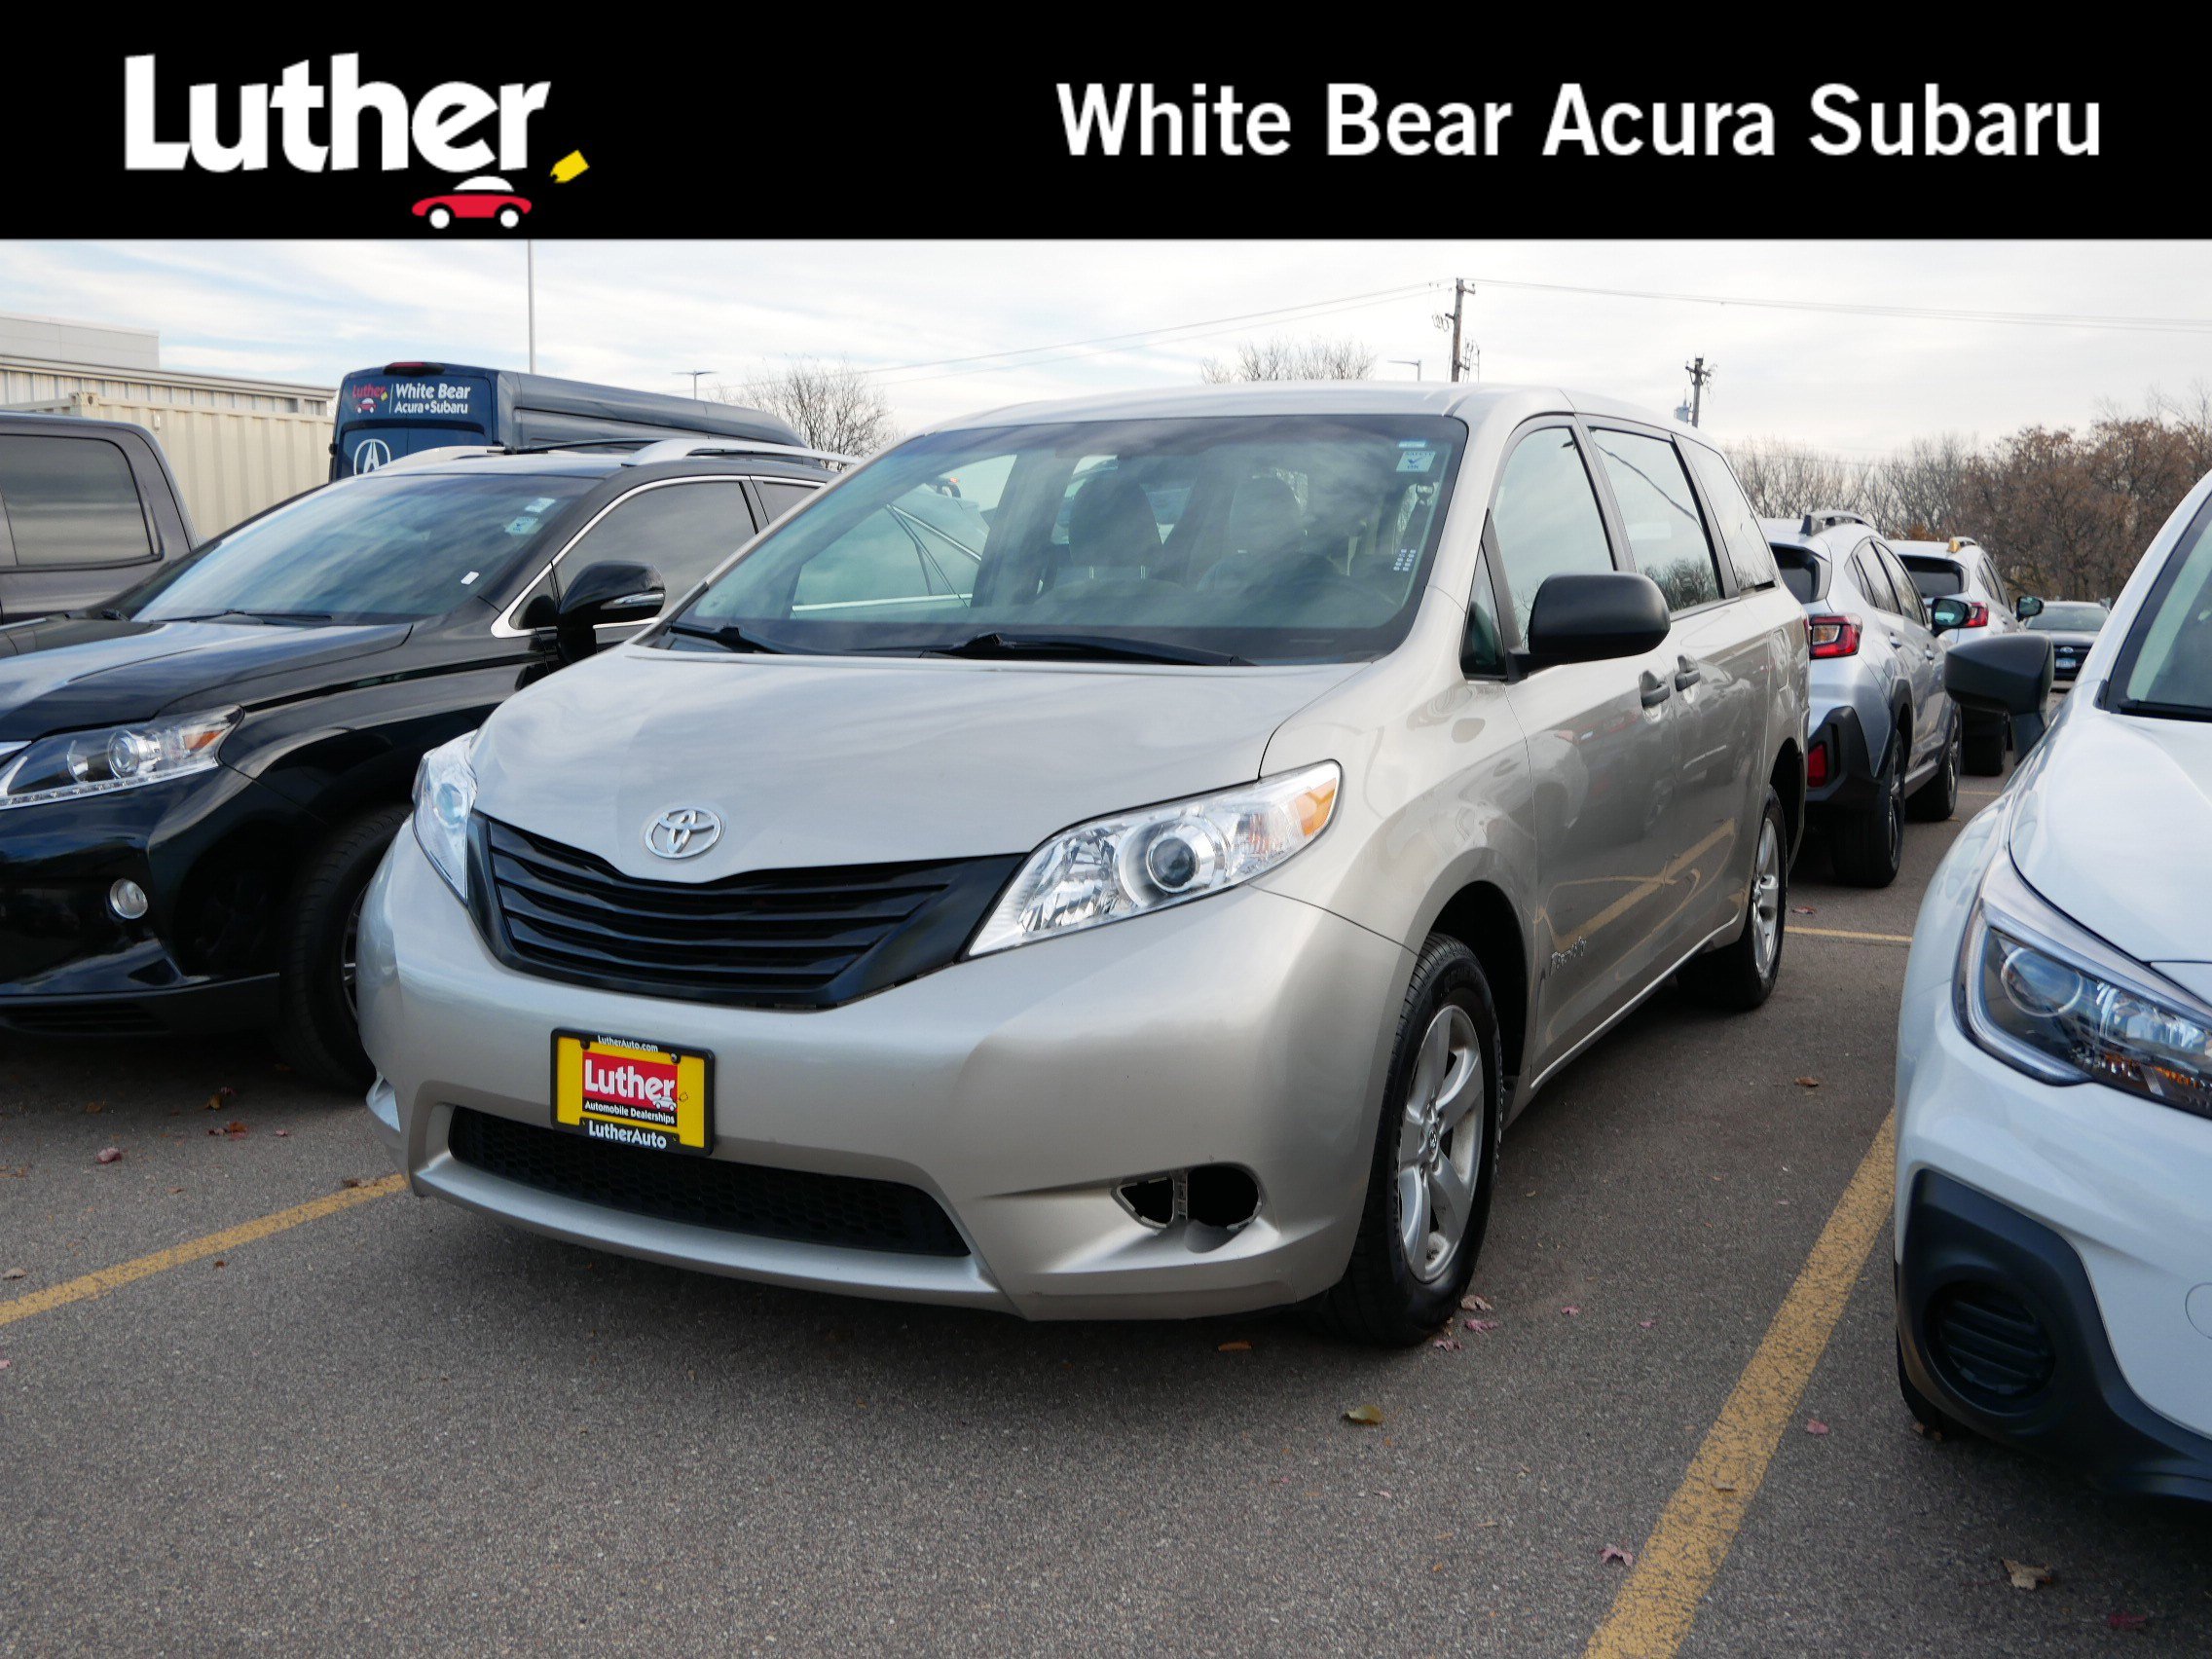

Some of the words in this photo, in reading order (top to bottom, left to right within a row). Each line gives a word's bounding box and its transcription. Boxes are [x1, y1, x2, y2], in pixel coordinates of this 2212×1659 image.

[351, 384, 387, 398] Luther
[395, 383, 434, 400] White
[438, 384, 470, 400] Bear
[598, 1035, 659, 1052] LutherAuto.com
[585, 1059, 676, 1103] Luther
[584, 1100, 629, 1116] Automobile
[630, 1108, 676, 1124] Dealerships
[589, 1121, 667, 1149] LutherAuto
